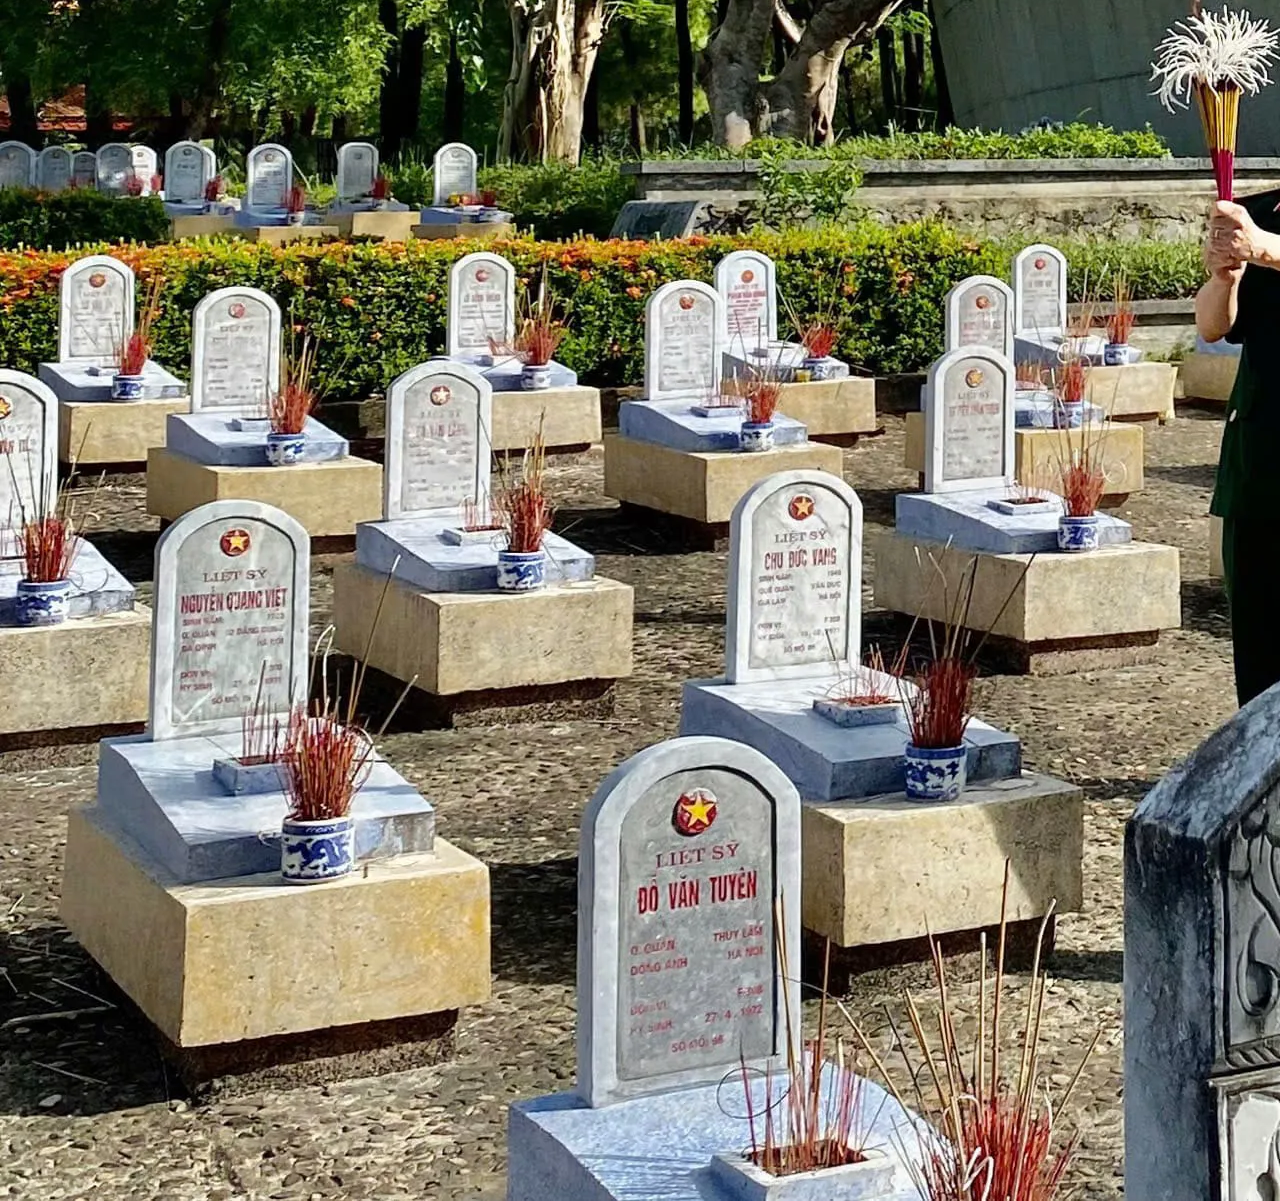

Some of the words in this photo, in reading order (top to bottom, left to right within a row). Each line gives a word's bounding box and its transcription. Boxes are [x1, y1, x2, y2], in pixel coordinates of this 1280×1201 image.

[764, 551, 784, 571] CHU
[226, 589, 262, 612] QUANG
[668, 875, 699, 910] VĂN
[709, 866, 758, 904] TUYÊN
